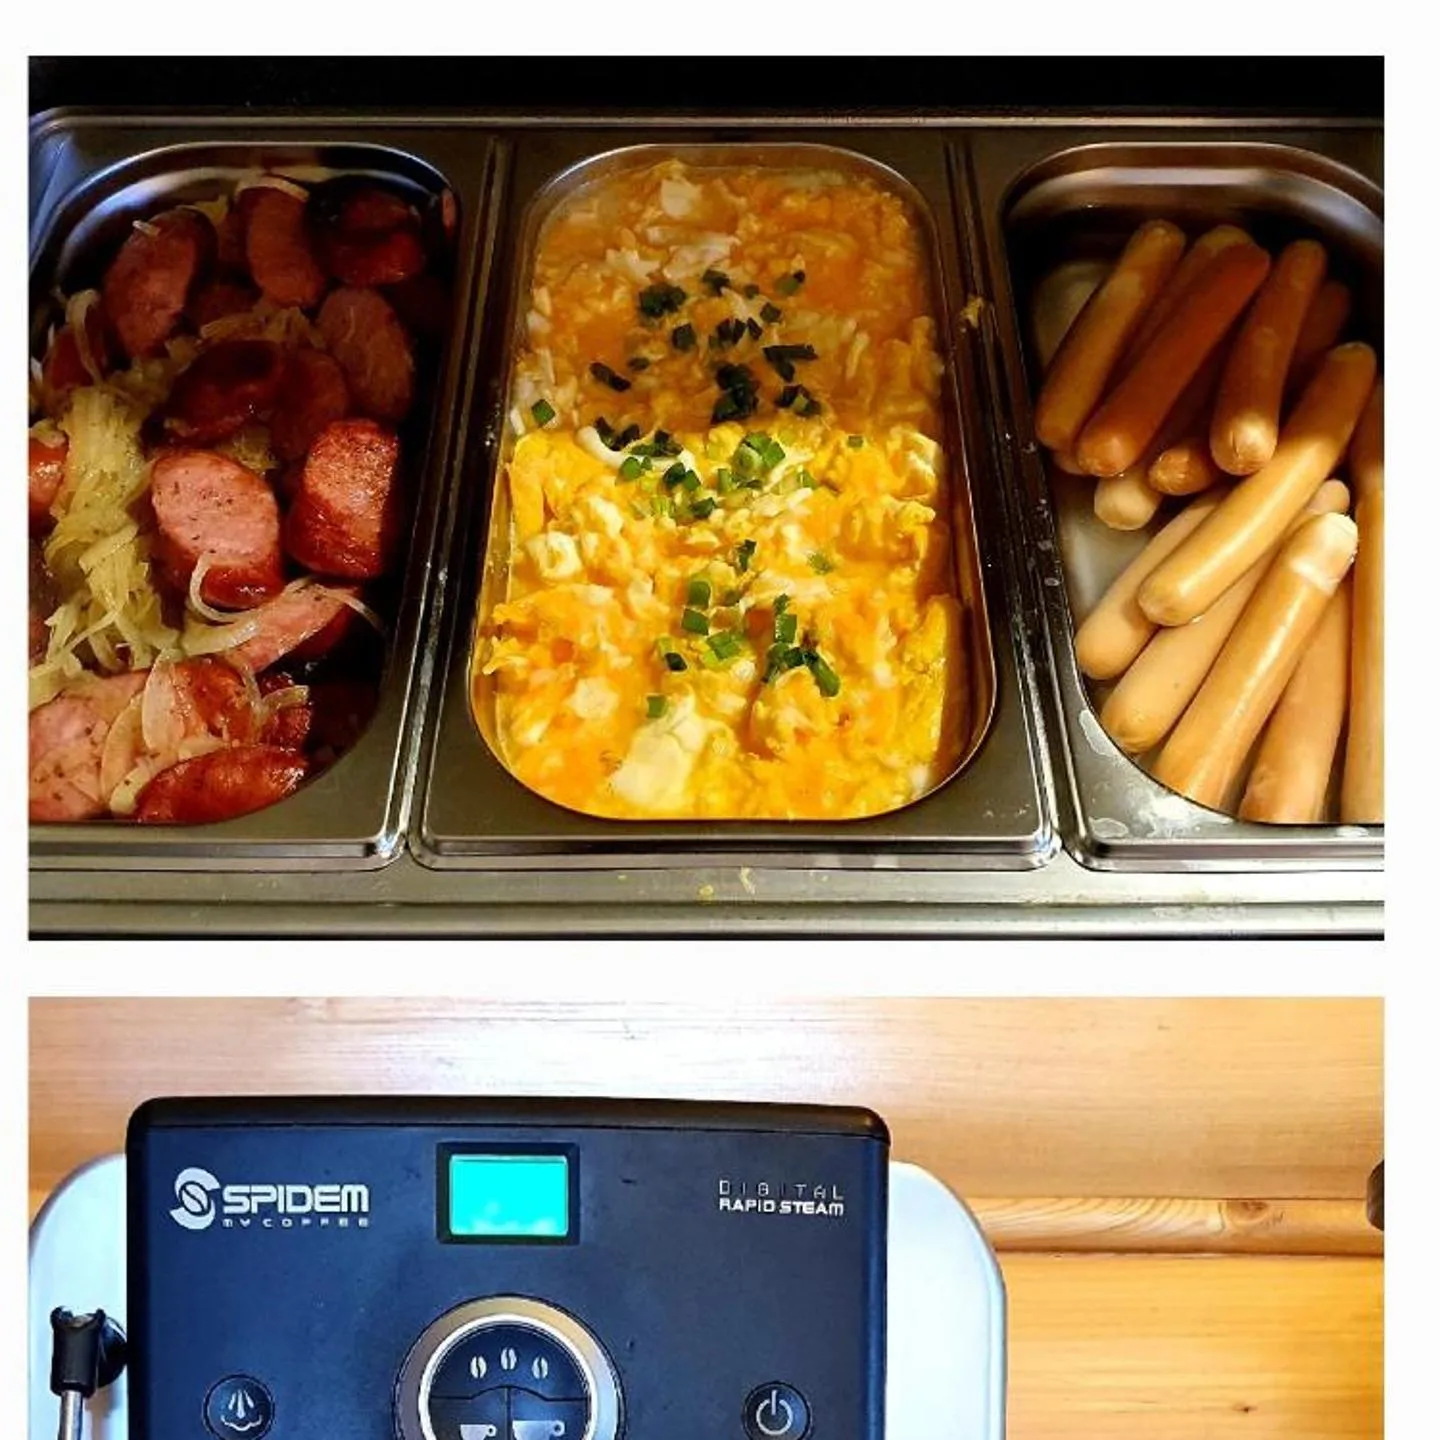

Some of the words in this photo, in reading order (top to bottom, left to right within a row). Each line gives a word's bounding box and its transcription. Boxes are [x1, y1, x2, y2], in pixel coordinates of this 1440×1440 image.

[222, 1184, 369, 1214] SPIDEM
[719, 1179, 844, 1201] DIGITAL
[719, 1198, 776, 1213] RAPID
[779, 1200, 844, 1216] STEAM
